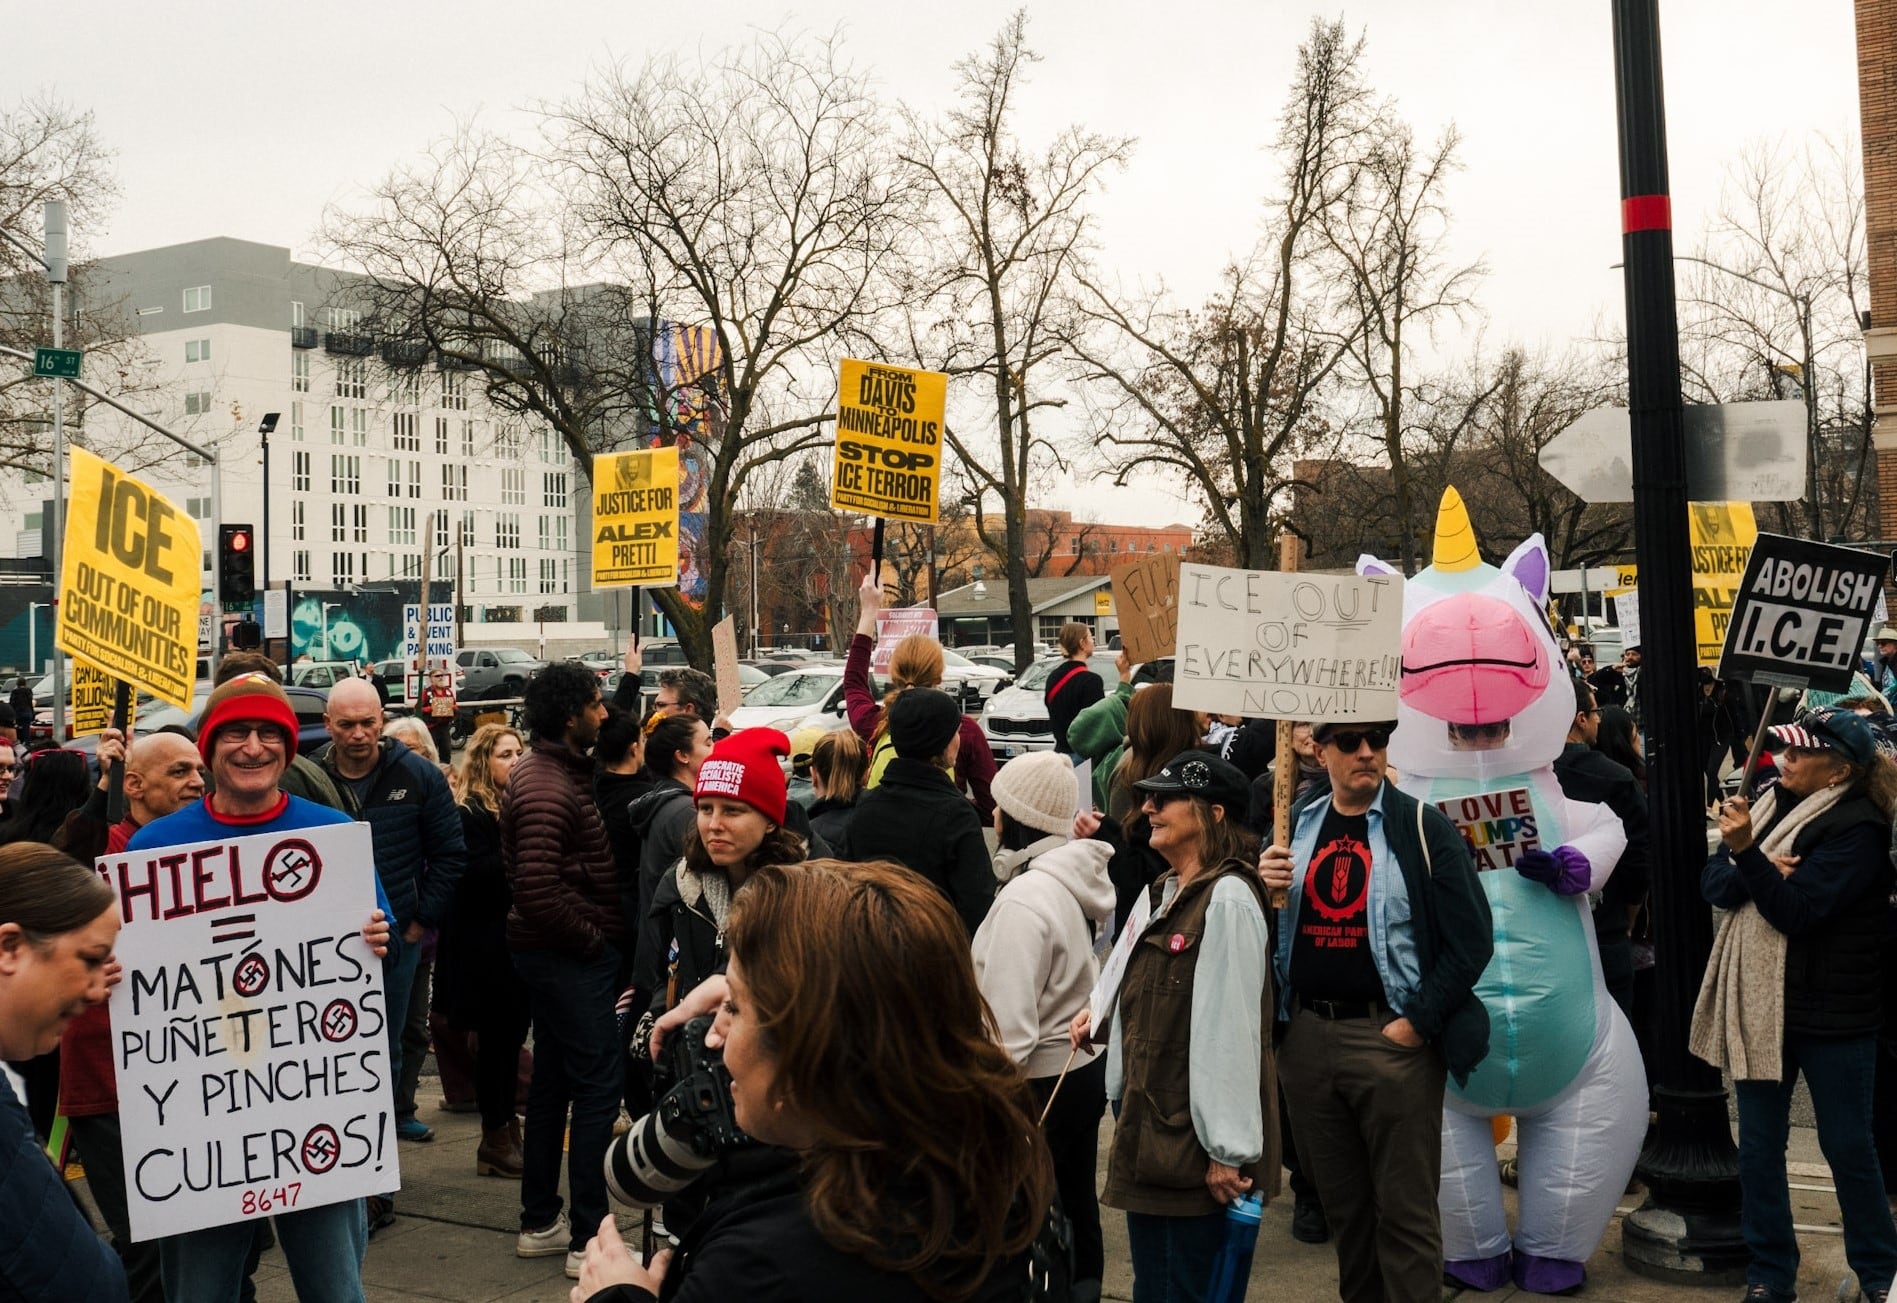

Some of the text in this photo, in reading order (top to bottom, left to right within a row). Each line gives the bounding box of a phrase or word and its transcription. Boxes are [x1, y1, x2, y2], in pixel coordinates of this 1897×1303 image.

[869, 368, 912, 383] FROM
[860, 374, 916, 414] DAVIS
[839, 405, 938, 446] MINNEAPOLIS
[877, 405, 897, 416] TO
[840, 440, 934, 471] STOP
[838, 461, 932, 502] ICE TERROR
[597, 487, 672, 516] JUSTICE FOR
[95, 467, 175, 587] ICE
[597, 521, 673, 543] ALEX
[612, 542, 656, 567] PRETTI
[1692, 545, 1752, 574] USTICE FO
[1190, 572, 1389, 622] ICE OUT
[1751, 557, 1877, 611] ABOLISH
[76, 561, 180, 640] OUT OF OUR
[65, 589, 189, 679] COMMUNITIES
[199, 617, 209, 627] NE
[200, 627, 211, 636] AY
[408, 626, 451, 639] & VENT
[1256, 621, 1308, 653] OF
[1741, 606, 1851, 666] I.C.E.
[64, 629, 87, 654] PARTY
[86, 640, 101, 660] FOR
[100, 648, 138, 677] SOCIALISM
[137, 666, 148, 681] &
[148, 669, 186, 700] LIBERATION
[407, 643, 453, 655] PAKING
[1243, 689, 1357, 715] NOW!!!
[699, 769, 743, 785] SOCIALISTS
[702, 780, 741, 796] AMERICA
[1455, 815, 1538, 847] RUMPS
[1303, 925, 1368, 937] AMERICAN PART
[1315, 937, 1357, 948] OF LABOR
[122, 990, 384, 1071] PUÑETEROS
[143, 1050, 381, 1126] Y PINCHES
[135, 1111, 388, 1202] CULEROS!
[241, 1182, 302, 1215] 8647
